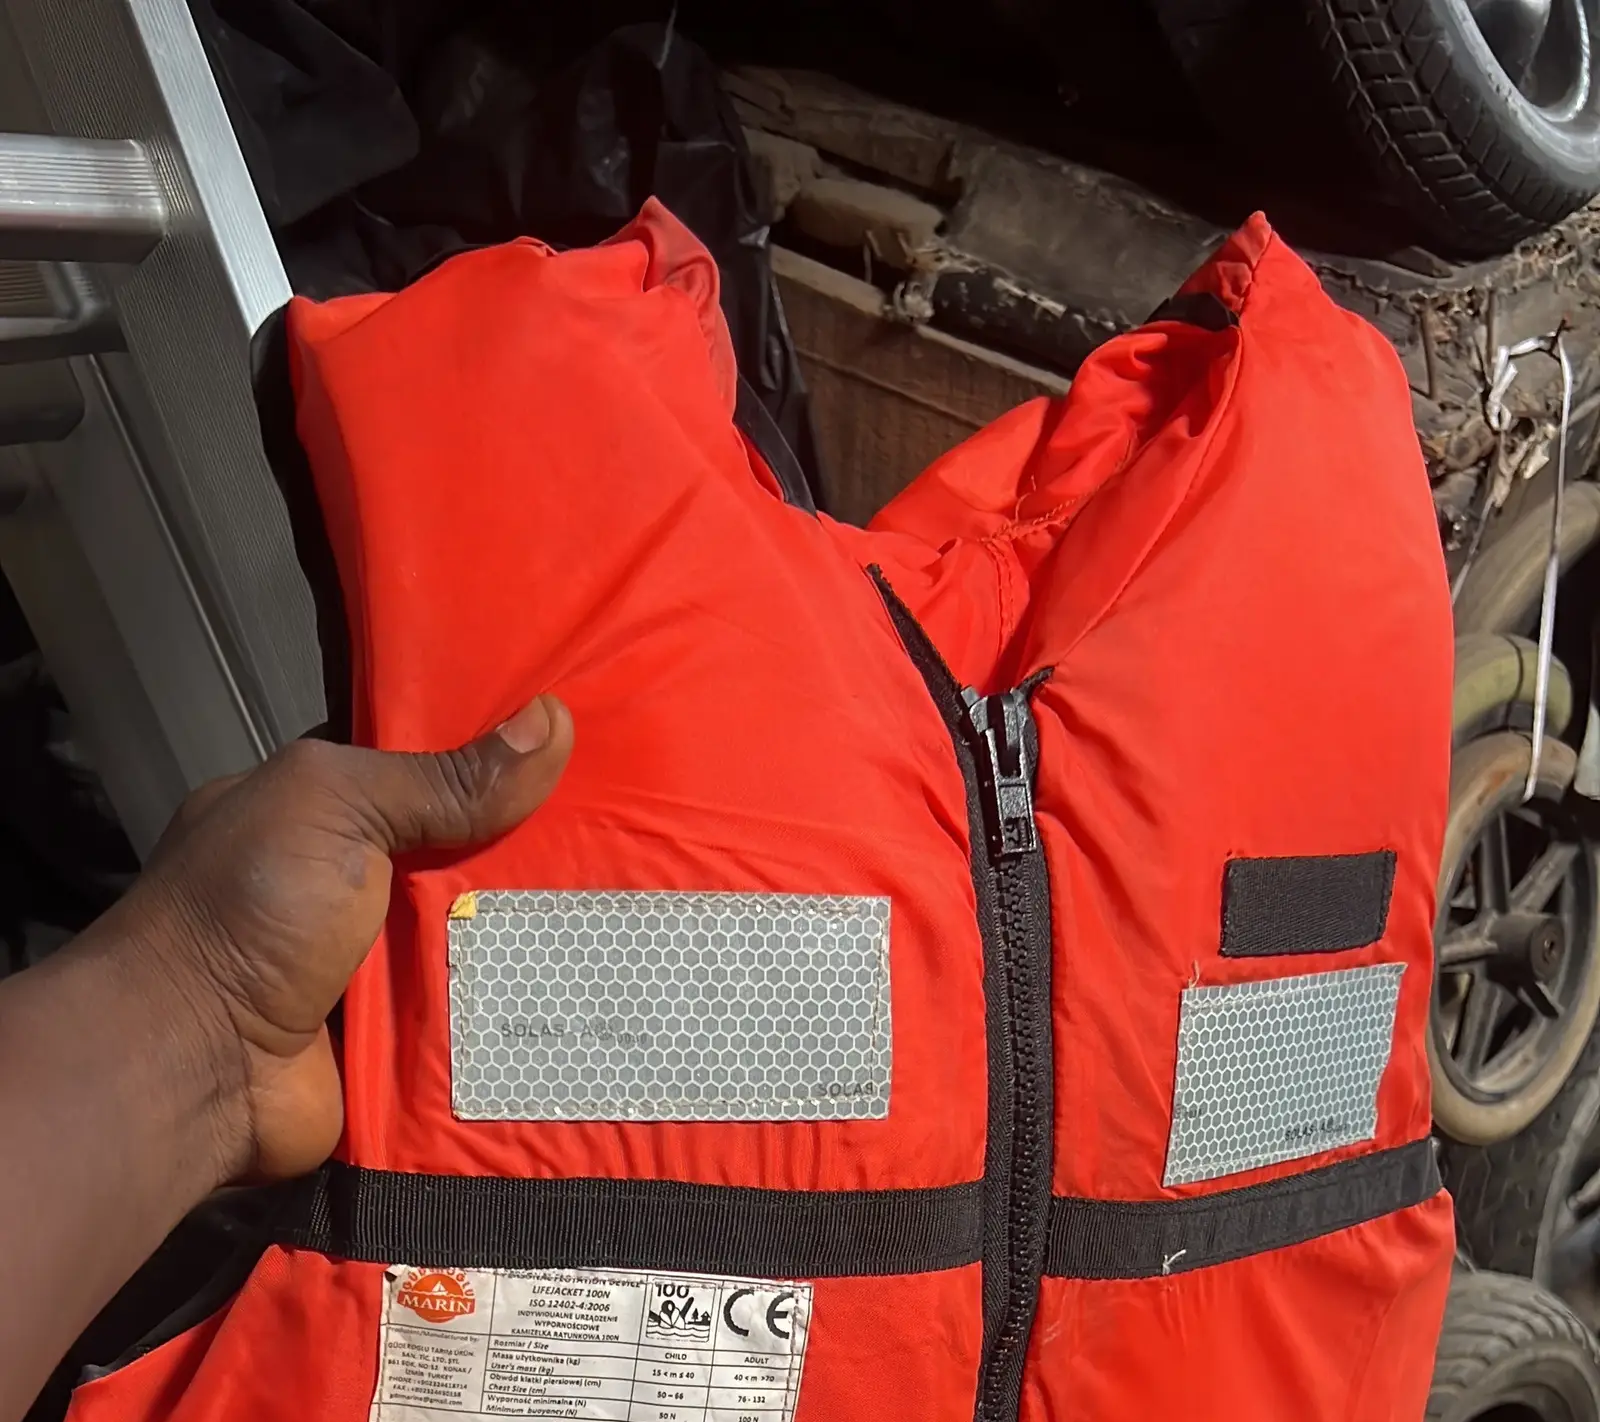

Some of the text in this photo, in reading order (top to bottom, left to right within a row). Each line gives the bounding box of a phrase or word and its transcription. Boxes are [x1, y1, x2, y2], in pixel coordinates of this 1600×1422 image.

[532, 1285, 611, 1299] LIFEJACKET 100N
[655, 1282, 690, 1299] 100
[529, 1299, 611, 1312] ISO 12402-4:2006
[494, 1339, 525, 1348] Rozmiar
[534, 1341, 549, 1350] Size
[492, 1352, 513, 1360] Masa
[664, 1352, 688, 1361] CHILD
[744, 1356, 770, 1365] ADULT
[516, 1365, 537, 1373] mass
[652, 1369, 662, 1377] 15
[489, 1373, 517, 1382] Obwód
[734, 1374, 744, 1382] 40
[488, 1383, 511, 1392] Chest
[512, 1385, 527, 1394] Size
[657, 1391, 667, 1399] 50
[738, 1395, 766, 1404] 76 132
[574, 1400, 587, 1408] (N)
[486, 1404, 524, 1413] Minimum
[527, 1407, 564, 1416] buoyancy
